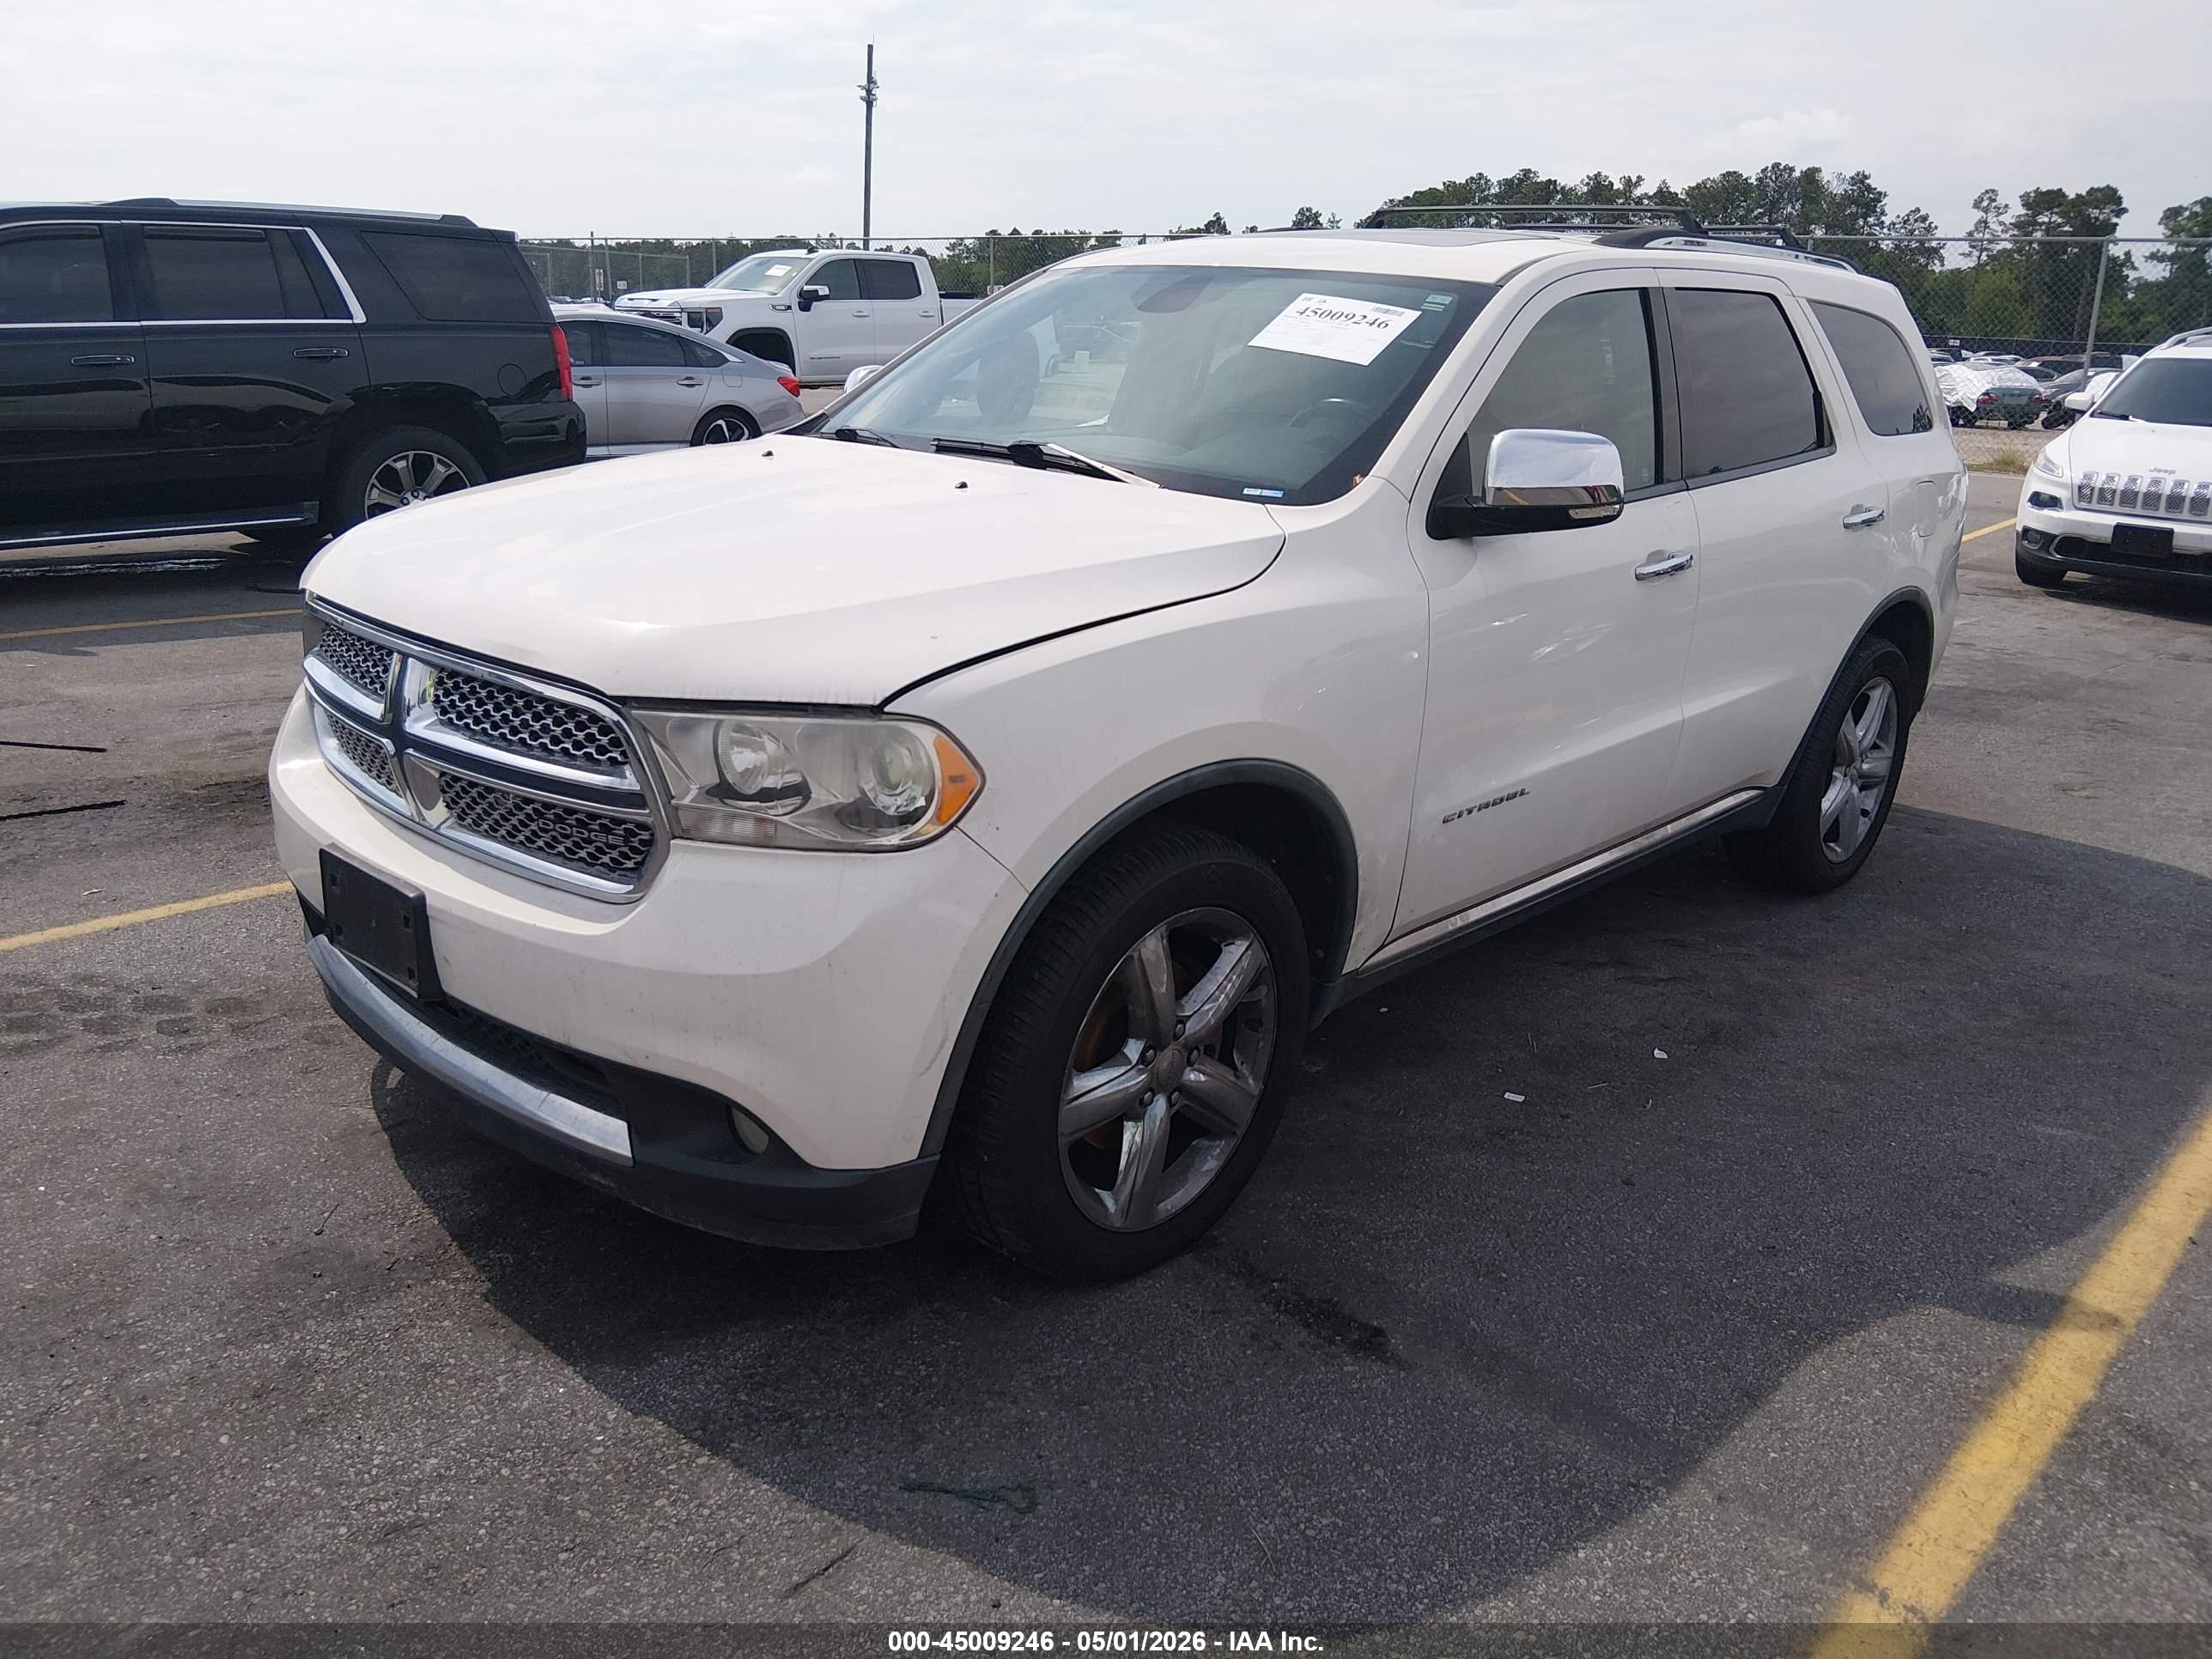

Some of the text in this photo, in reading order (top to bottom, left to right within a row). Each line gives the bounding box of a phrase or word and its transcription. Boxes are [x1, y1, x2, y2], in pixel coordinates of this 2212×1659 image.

[1295, 306, 1393, 330] 45009246
[1442, 787, 1531, 824] CITADEL
[537, 818, 627, 846] DODGE
